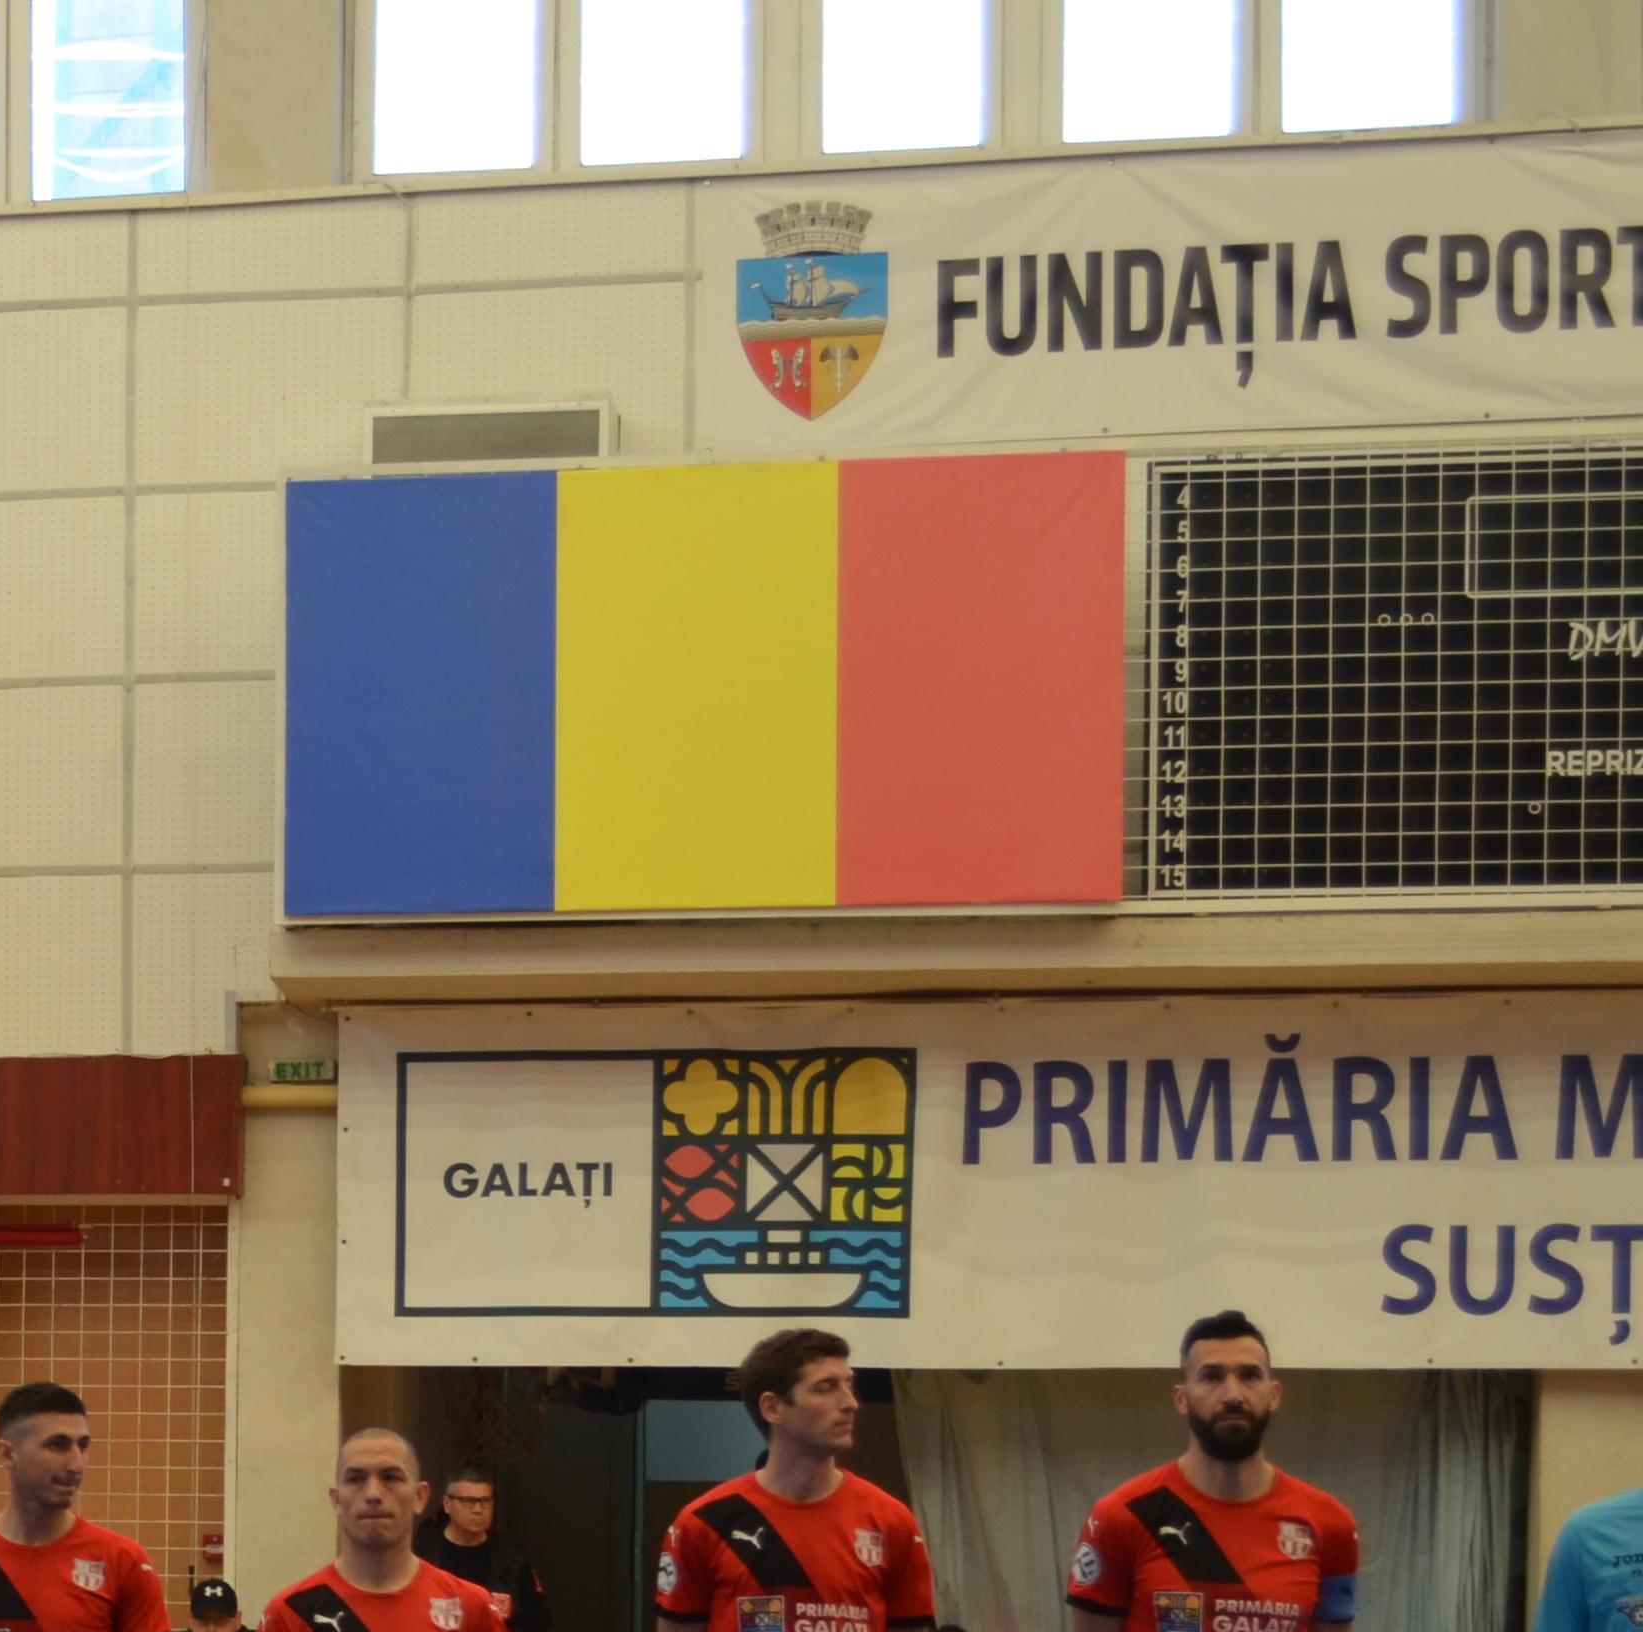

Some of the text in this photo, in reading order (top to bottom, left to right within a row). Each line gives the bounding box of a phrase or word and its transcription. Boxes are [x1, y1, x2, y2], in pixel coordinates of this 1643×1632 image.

[936, 240, 1357, 389] FUNDAȚIA
[1177, 485, 1190, 508] 4
[1177, 520, 1190, 543] 5
[1176, 555, 1189, 579] 6
[1176, 591, 1189, 613] 7
[1175, 625, 1189, 648] 8
[1174, 659, 1188, 683] 9
[1162, 692, 1188, 715] 10
[1163, 727, 1187, 749] 11
[1161, 760, 1187, 784] 12
[1161, 796, 1186, 818] 13
[1161, 831, 1185, 853] 14
[1160, 865, 1185, 888] 15
[275, 1061, 324, 1079] EXIT
[961, 1032, 1519, 1165] PRIMĂRIA
[443, 1162, 613, 1209] GALAȚI
